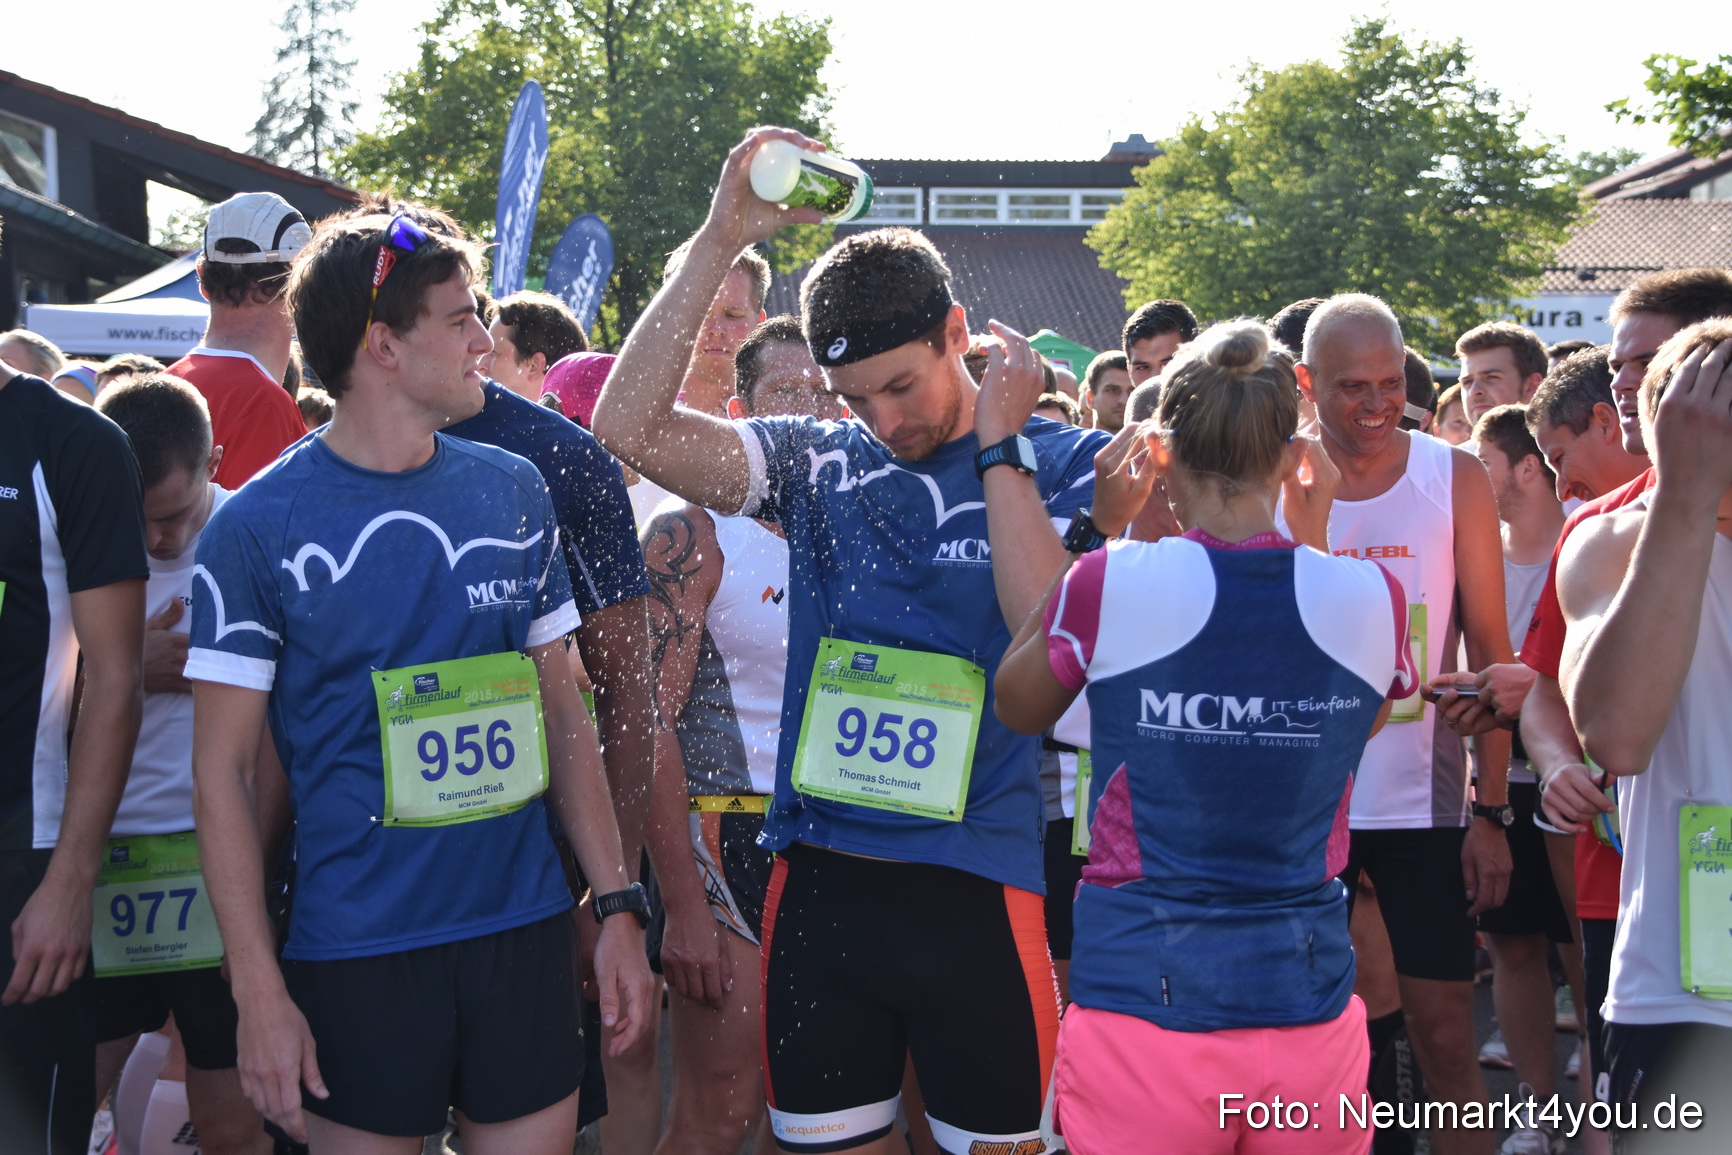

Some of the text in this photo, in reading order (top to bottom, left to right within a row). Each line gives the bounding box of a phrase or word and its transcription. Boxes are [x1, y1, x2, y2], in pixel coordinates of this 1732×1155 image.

[373, 247, 386, 286] RUDY
[569, 239, 598, 316] cher
[1526, 309, 1583, 327] ura
[107, 326, 204, 342] www.fisch
[465, 579, 517, 606] MCM
[838, 666, 897, 685] firmenlauf
[405, 686, 462, 706] firmenlauf
[464, 689, 492, 703] 2015
[895, 682, 927, 696] 2015
[1139, 688, 1265, 731] MCM
[1272, 695, 1360, 714] IT-Einfach
[835, 707, 938, 769] 958
[1137, 727, 1319, 748] MICRO COMPUTER MANAGING
[417, 718, 516, 782] 956
[838, 768, 921, 790] Thomas Schmidt
[438, 782, 505, 802] Raimund Rieß
[874, 788, 891, 796] GmbH
[458, 799, 488, 809] MCM GmbH
[110, 888, 198, 938] 977
[125, 942, 188, 955] Stefan Bergler
[785, 1122, 846, 1136] acquatico
